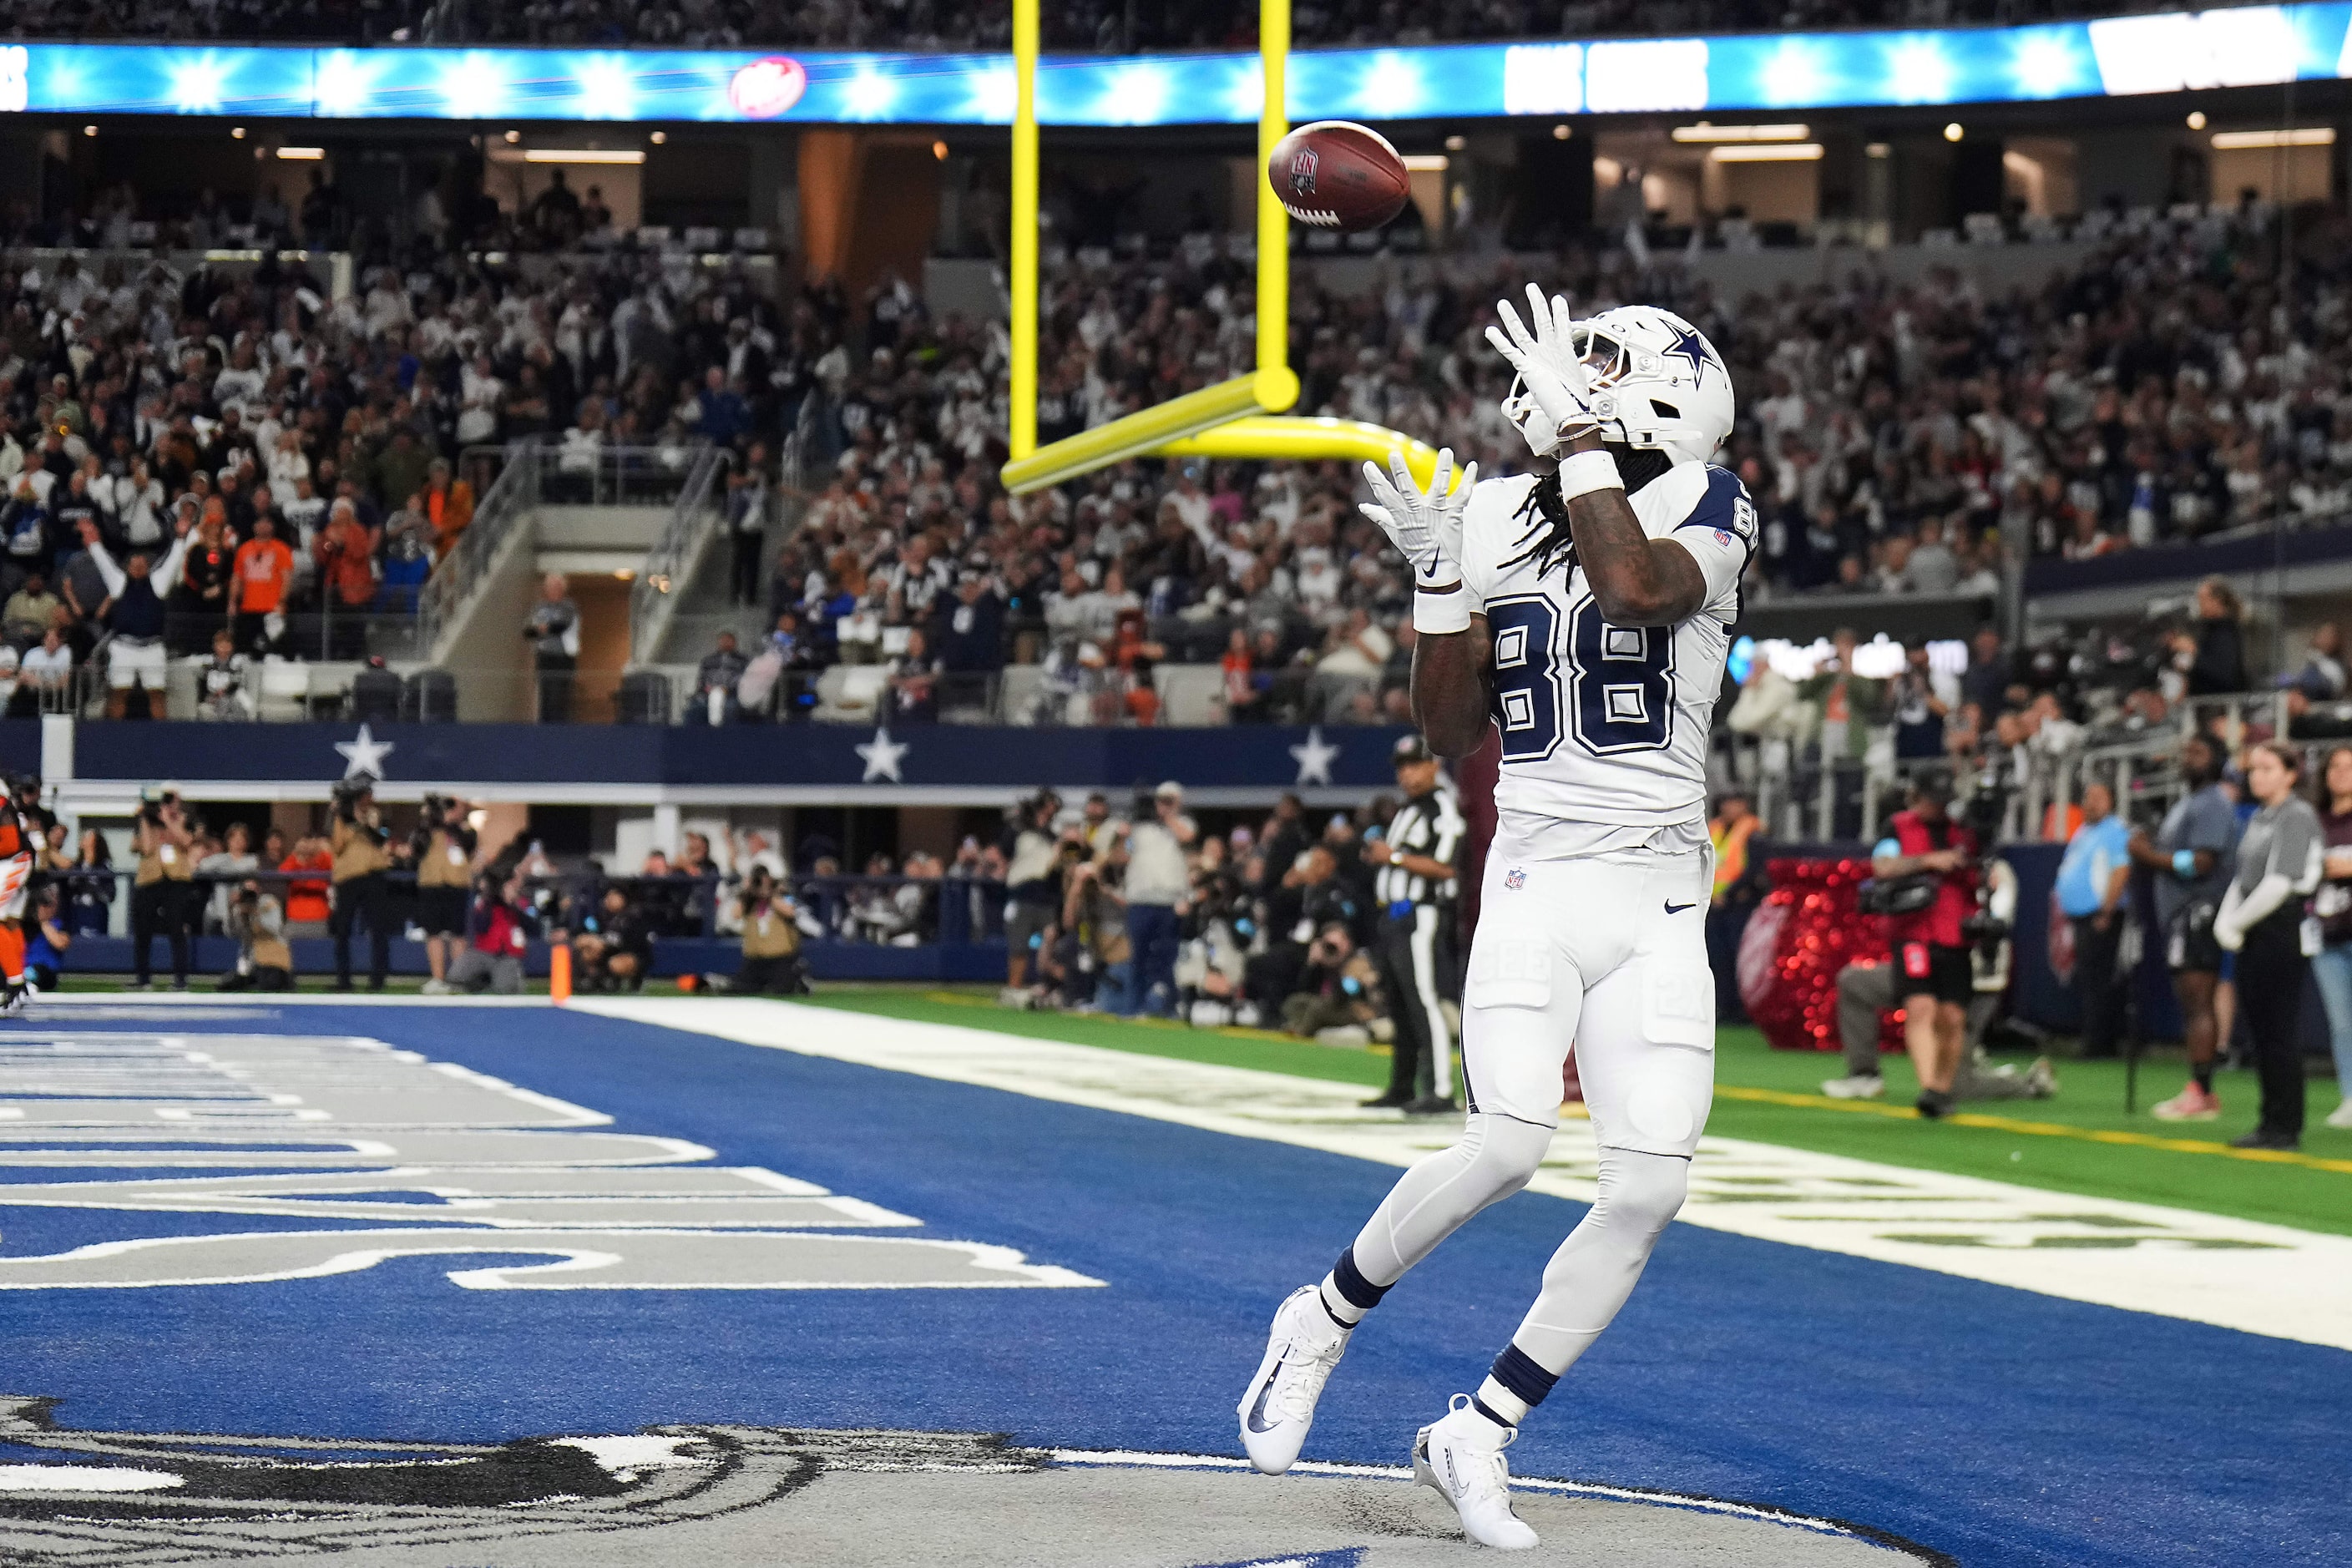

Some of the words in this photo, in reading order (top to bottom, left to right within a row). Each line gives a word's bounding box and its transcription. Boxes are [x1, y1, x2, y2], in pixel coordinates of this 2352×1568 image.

[1293, 154, 1314, 175] NFL
[1715, 531, 1731, 546] NFL
[1484, 592, 1677, 764] 88
[1506, 875, 1524, 888] NFL
